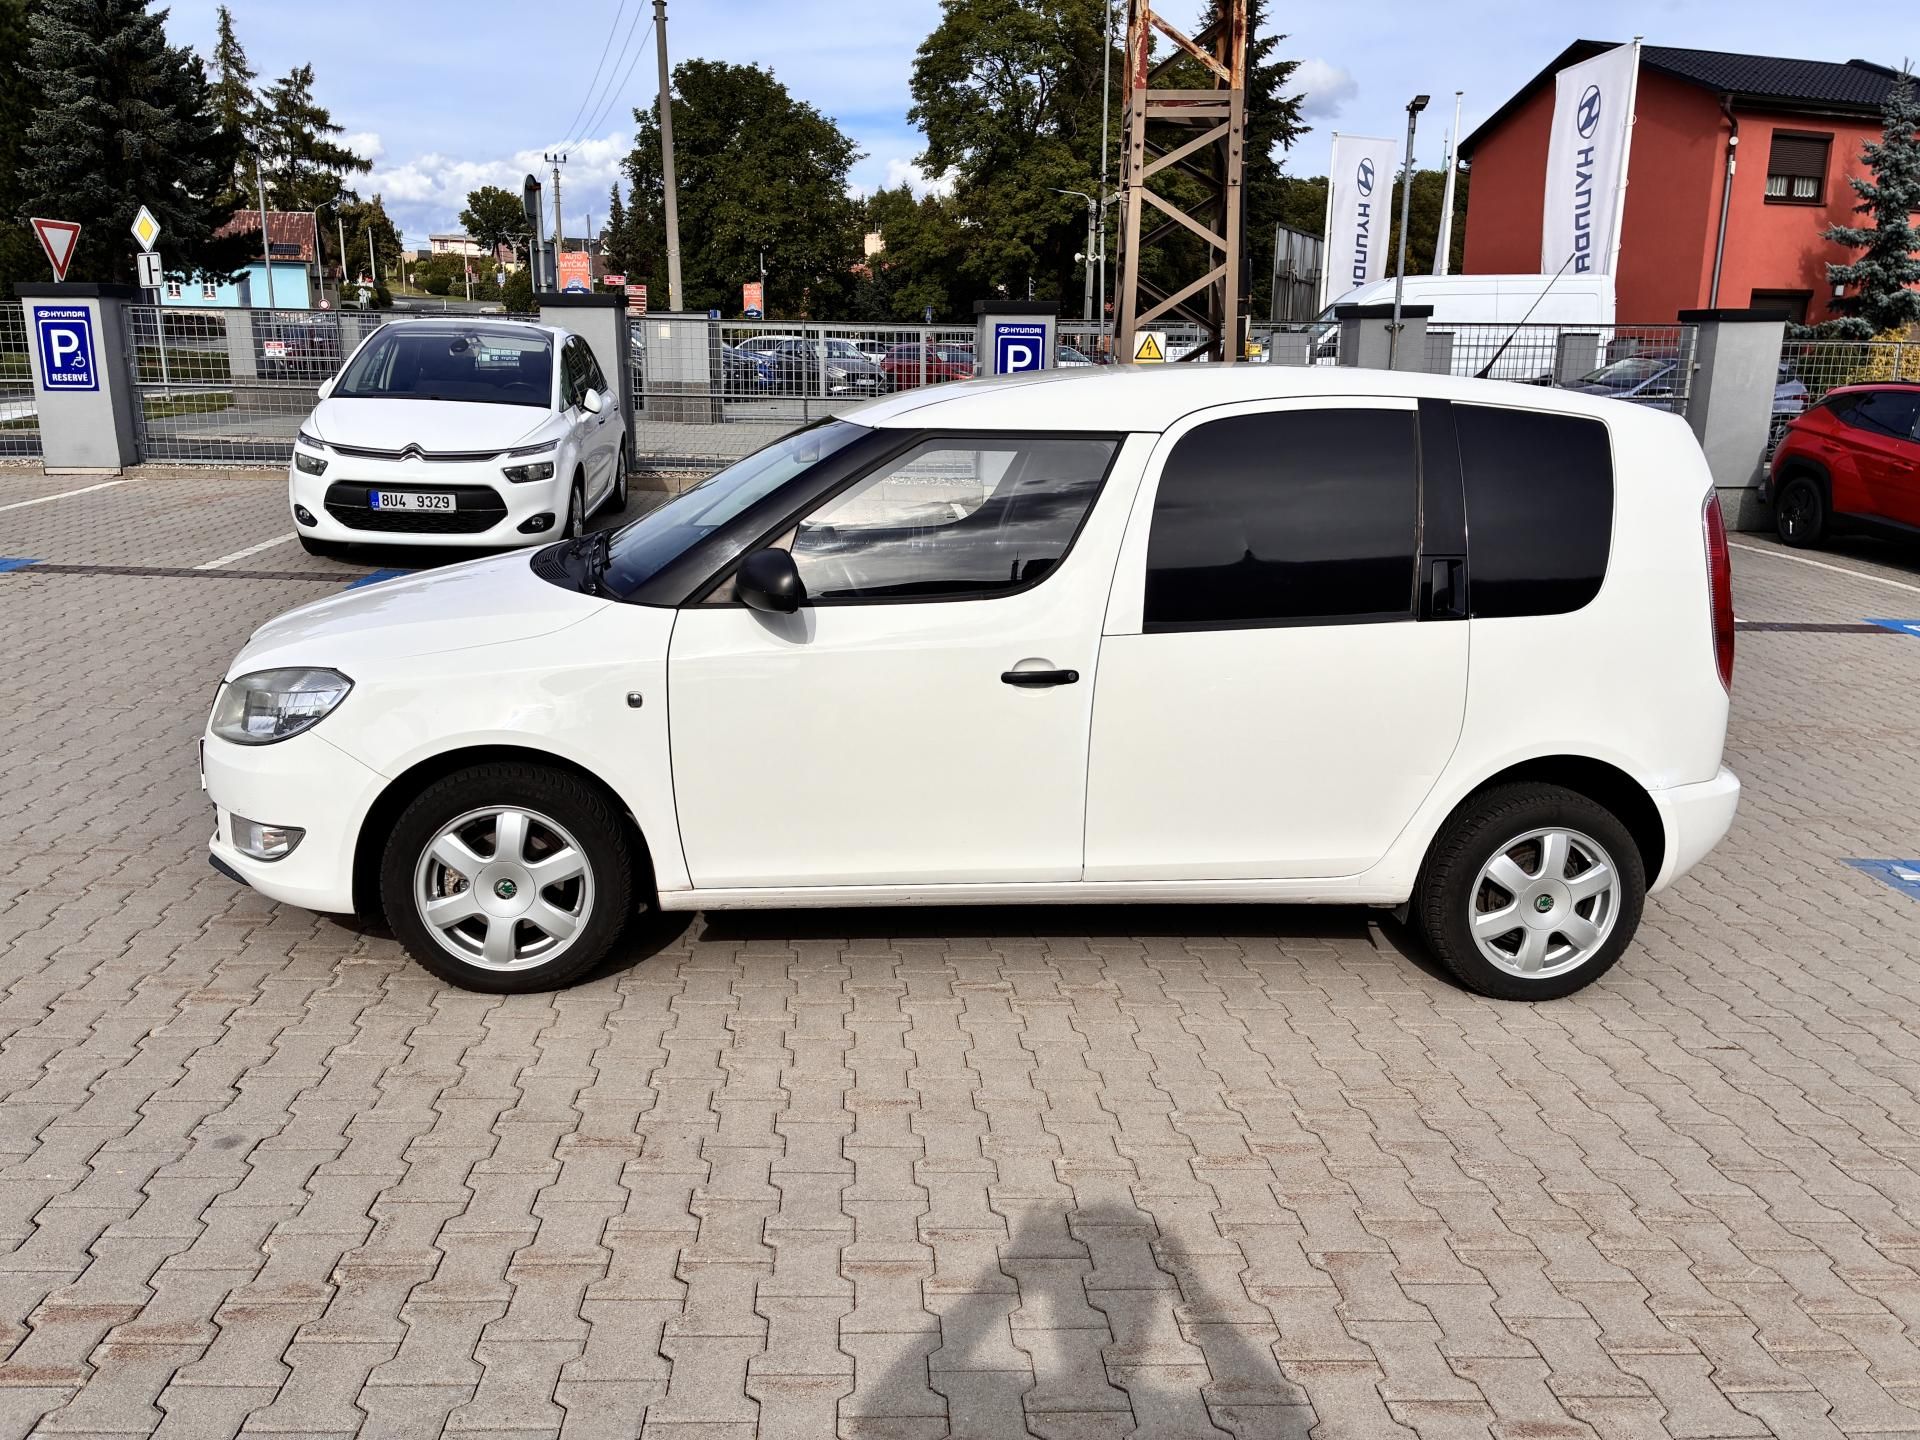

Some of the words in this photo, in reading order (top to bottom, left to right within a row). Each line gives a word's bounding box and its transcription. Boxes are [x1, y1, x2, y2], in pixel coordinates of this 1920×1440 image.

[560, 260, 587, 268] MYČKA
[50, 310, 86, 318] HYUNDAI
[50, 329, 79, 368] P
[1007, 344, 1032, 374] P
[52, 372, 89, 382] RESERVÉ
[382, 494, 406, 507] 8U4
[417, 495, 450, 508] 9329
